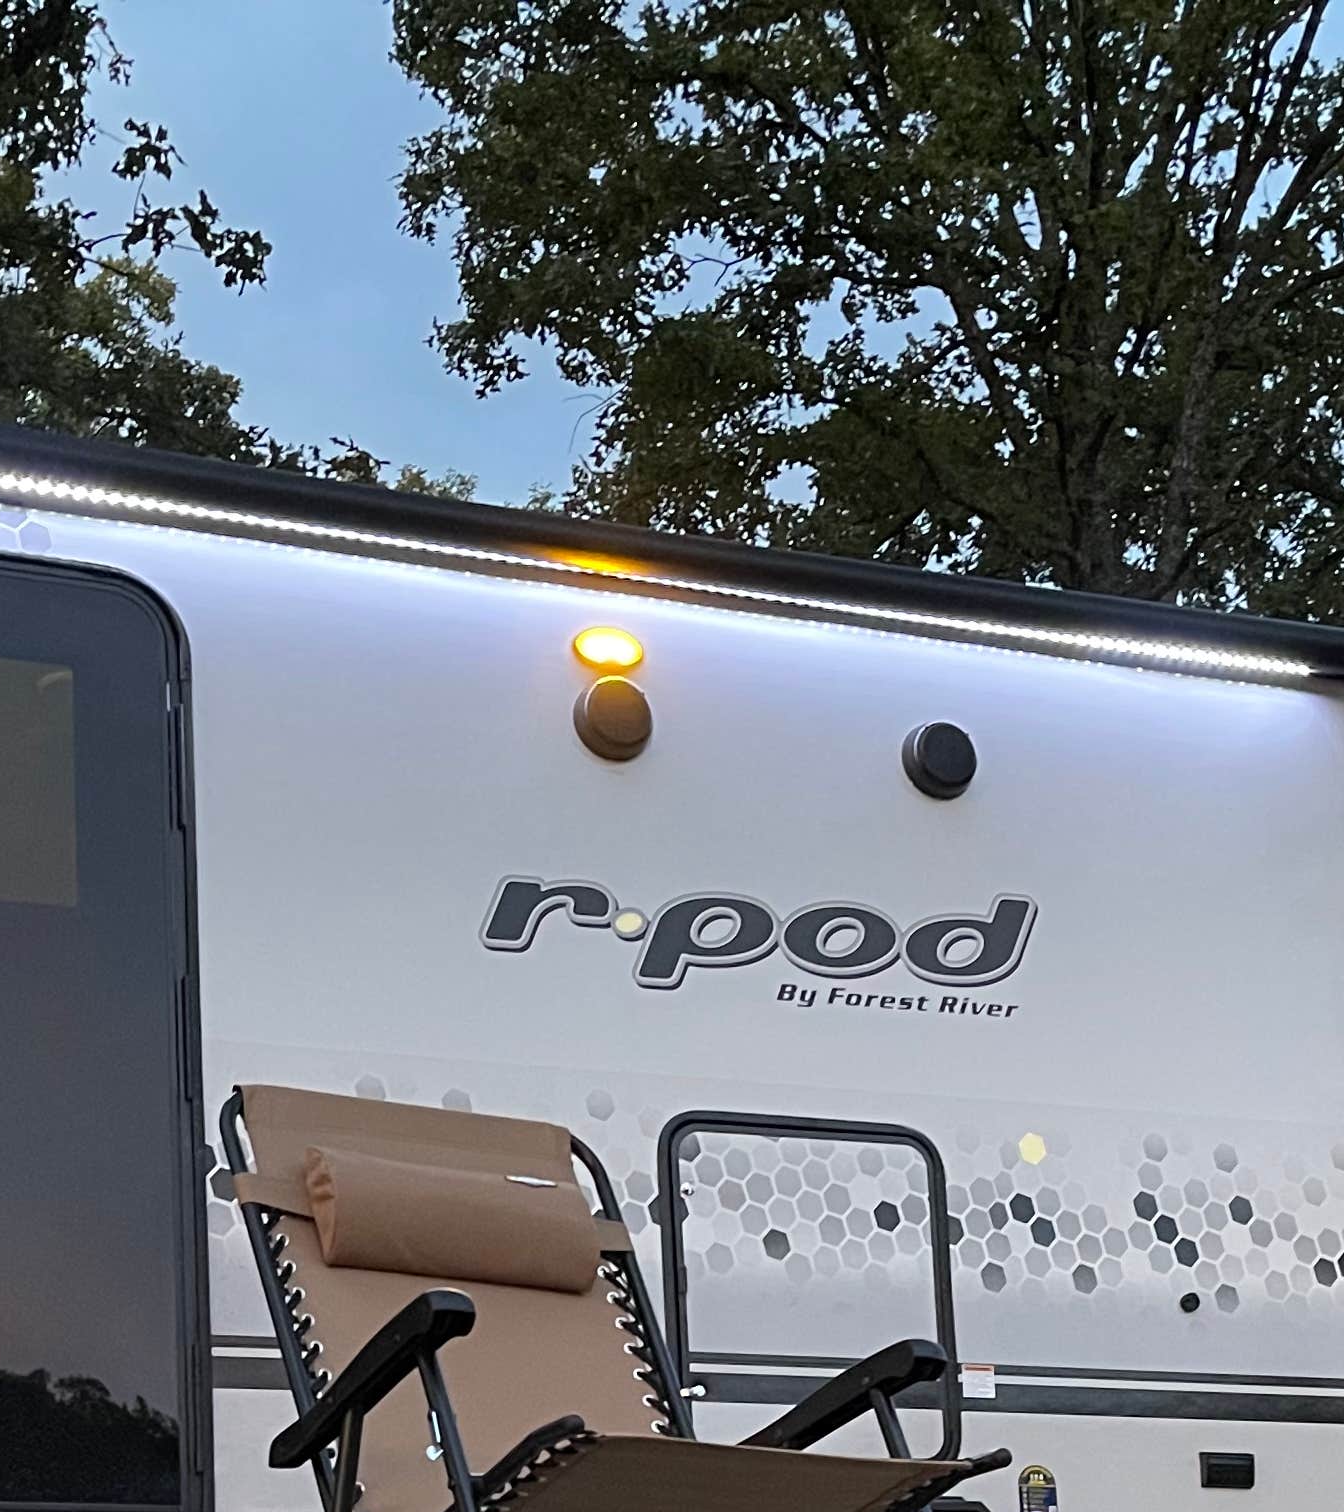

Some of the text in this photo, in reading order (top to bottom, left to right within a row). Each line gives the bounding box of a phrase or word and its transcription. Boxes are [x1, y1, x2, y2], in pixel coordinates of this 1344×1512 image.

[776, 983, 1019, 1018] By Forest River
